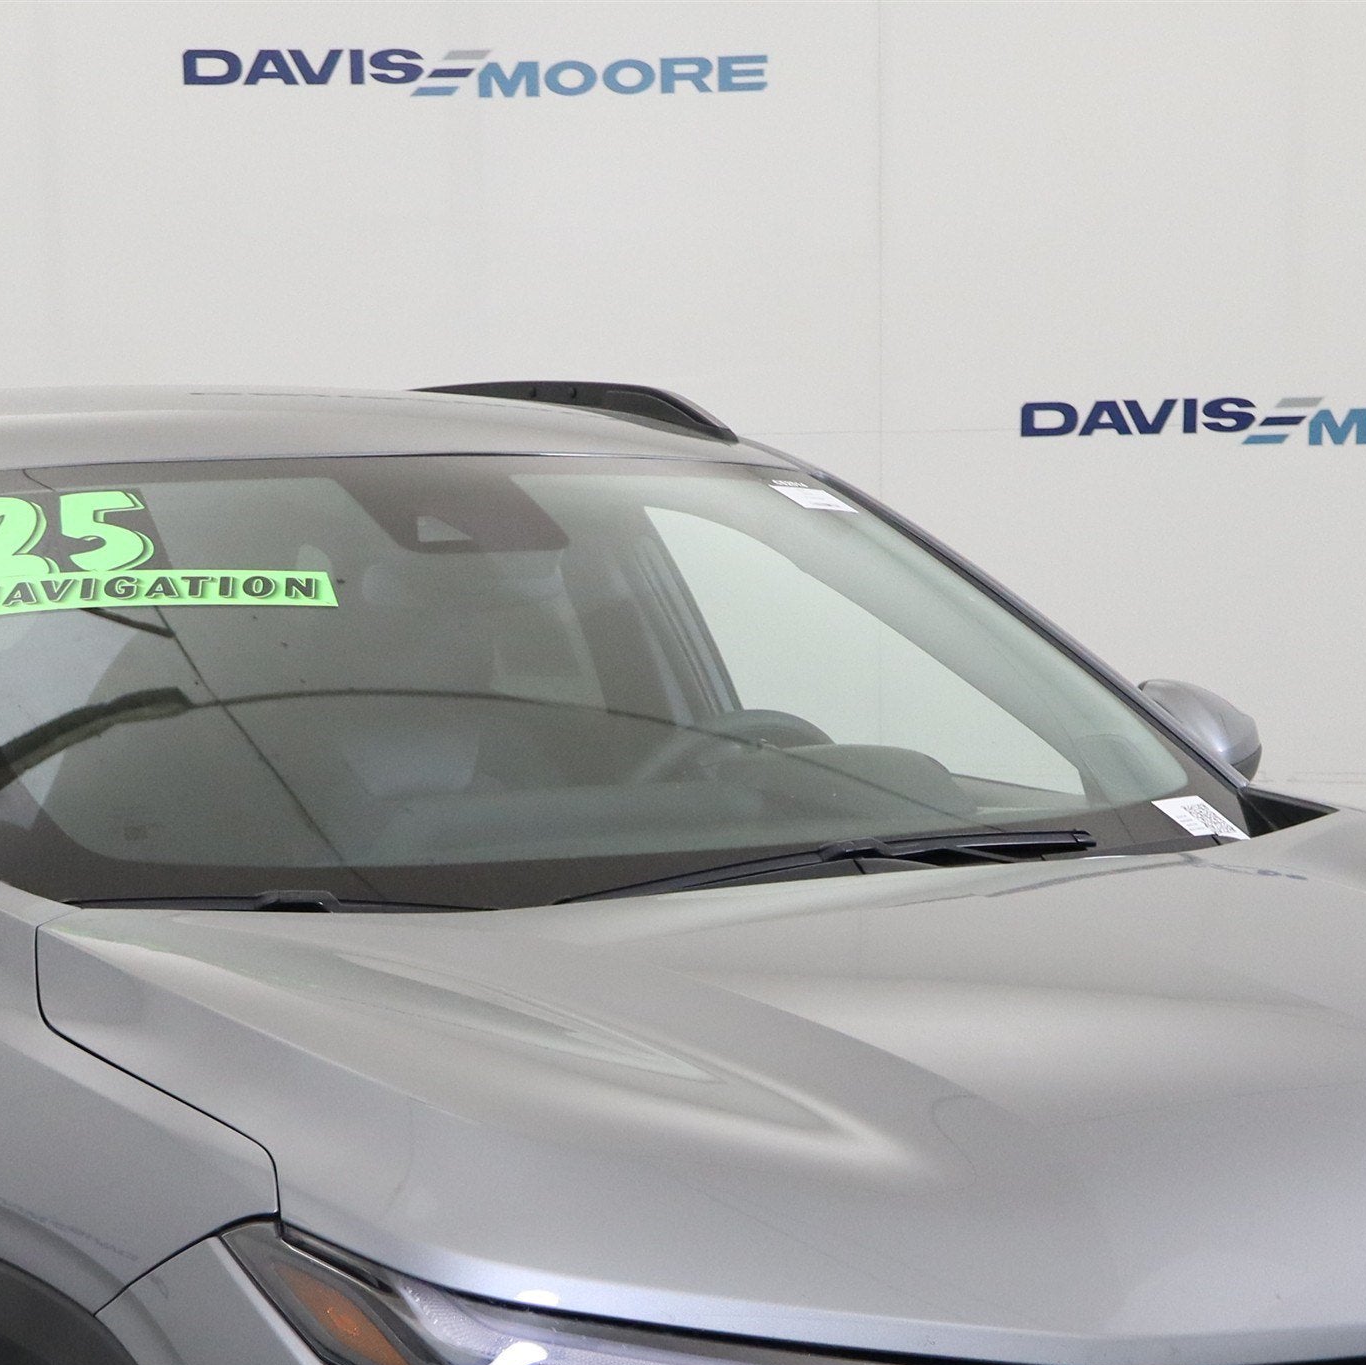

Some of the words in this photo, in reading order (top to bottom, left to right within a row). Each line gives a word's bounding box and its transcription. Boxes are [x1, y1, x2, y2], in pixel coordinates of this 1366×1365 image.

[182, 48, 425, 86] DAVIS
[477, 54, 768, 98] MOORE
[1020, 396, 1257, 438] DAVIS
